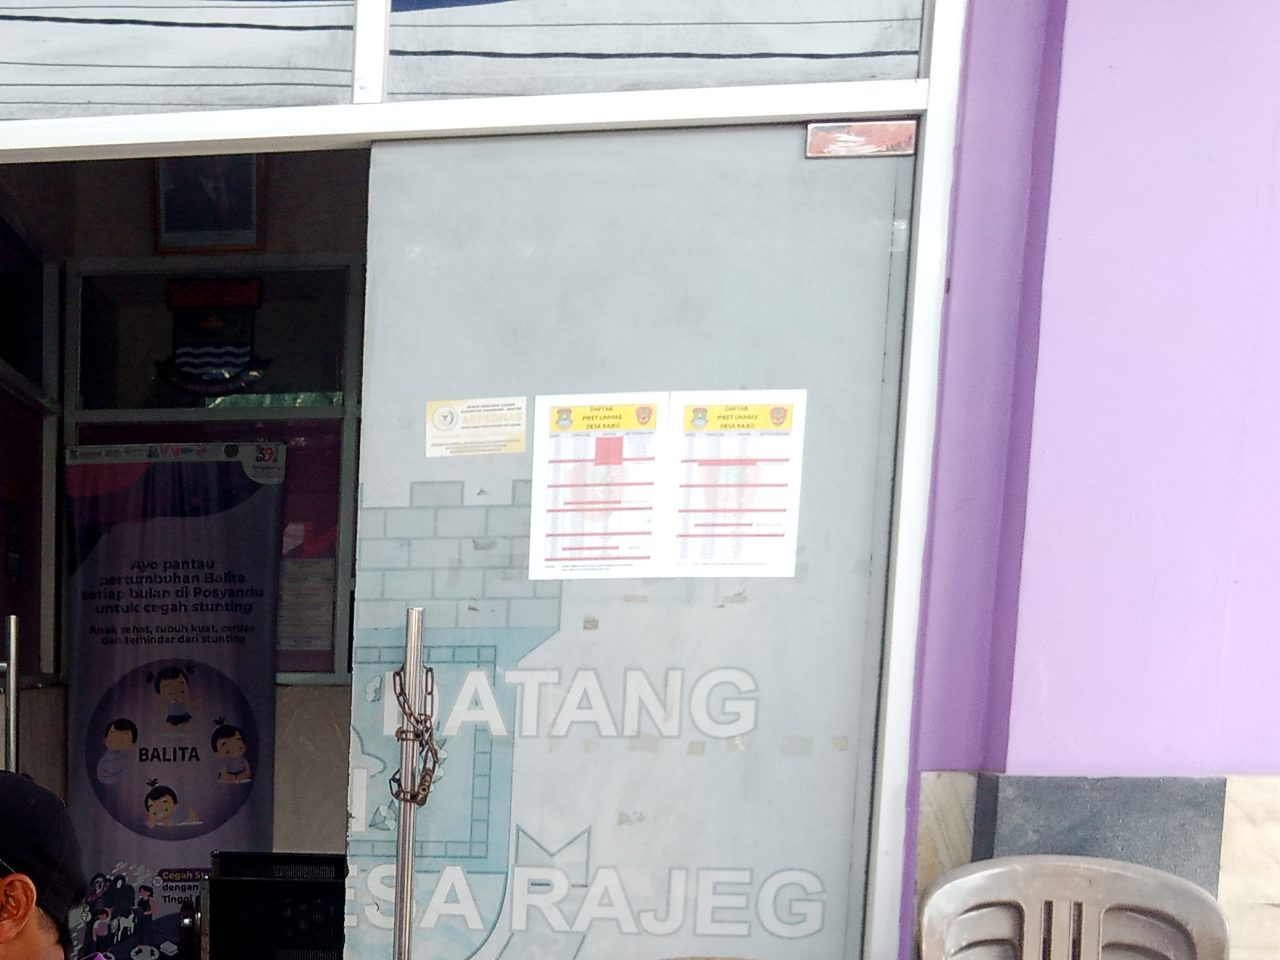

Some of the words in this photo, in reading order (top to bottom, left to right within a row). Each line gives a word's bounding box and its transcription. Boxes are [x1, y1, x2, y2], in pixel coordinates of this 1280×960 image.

[131, 560, 157, 572] Ayo
[163, 559, 215, 572] pantau
[99, 573, 200, 586] pertumbuhan
[204, 571, 246, 583] Balita
[81, 588, 123, 601] setiap
[129, 587, 170, 599] bulan
[175, 587, 189, 598] di
[193, 586, 263, 600] Posyandu
[96, 603, 139, 614] untuk
[143, 602, 188, 616] cegah
[192, 600, 253, 615] stunting
[156, 624, 188, 633] tubuh
[124, 635, 175, 645] terhindar
[177, 635, 198, 644] dari
[201, 634, 246, 646] stunting
[138, 746, 200, 763] BALITA
[162, 871, 193, 882] Cegah
[162, 883, 198, 893] dengan
[511, 866, 825, 939] RAJEG
